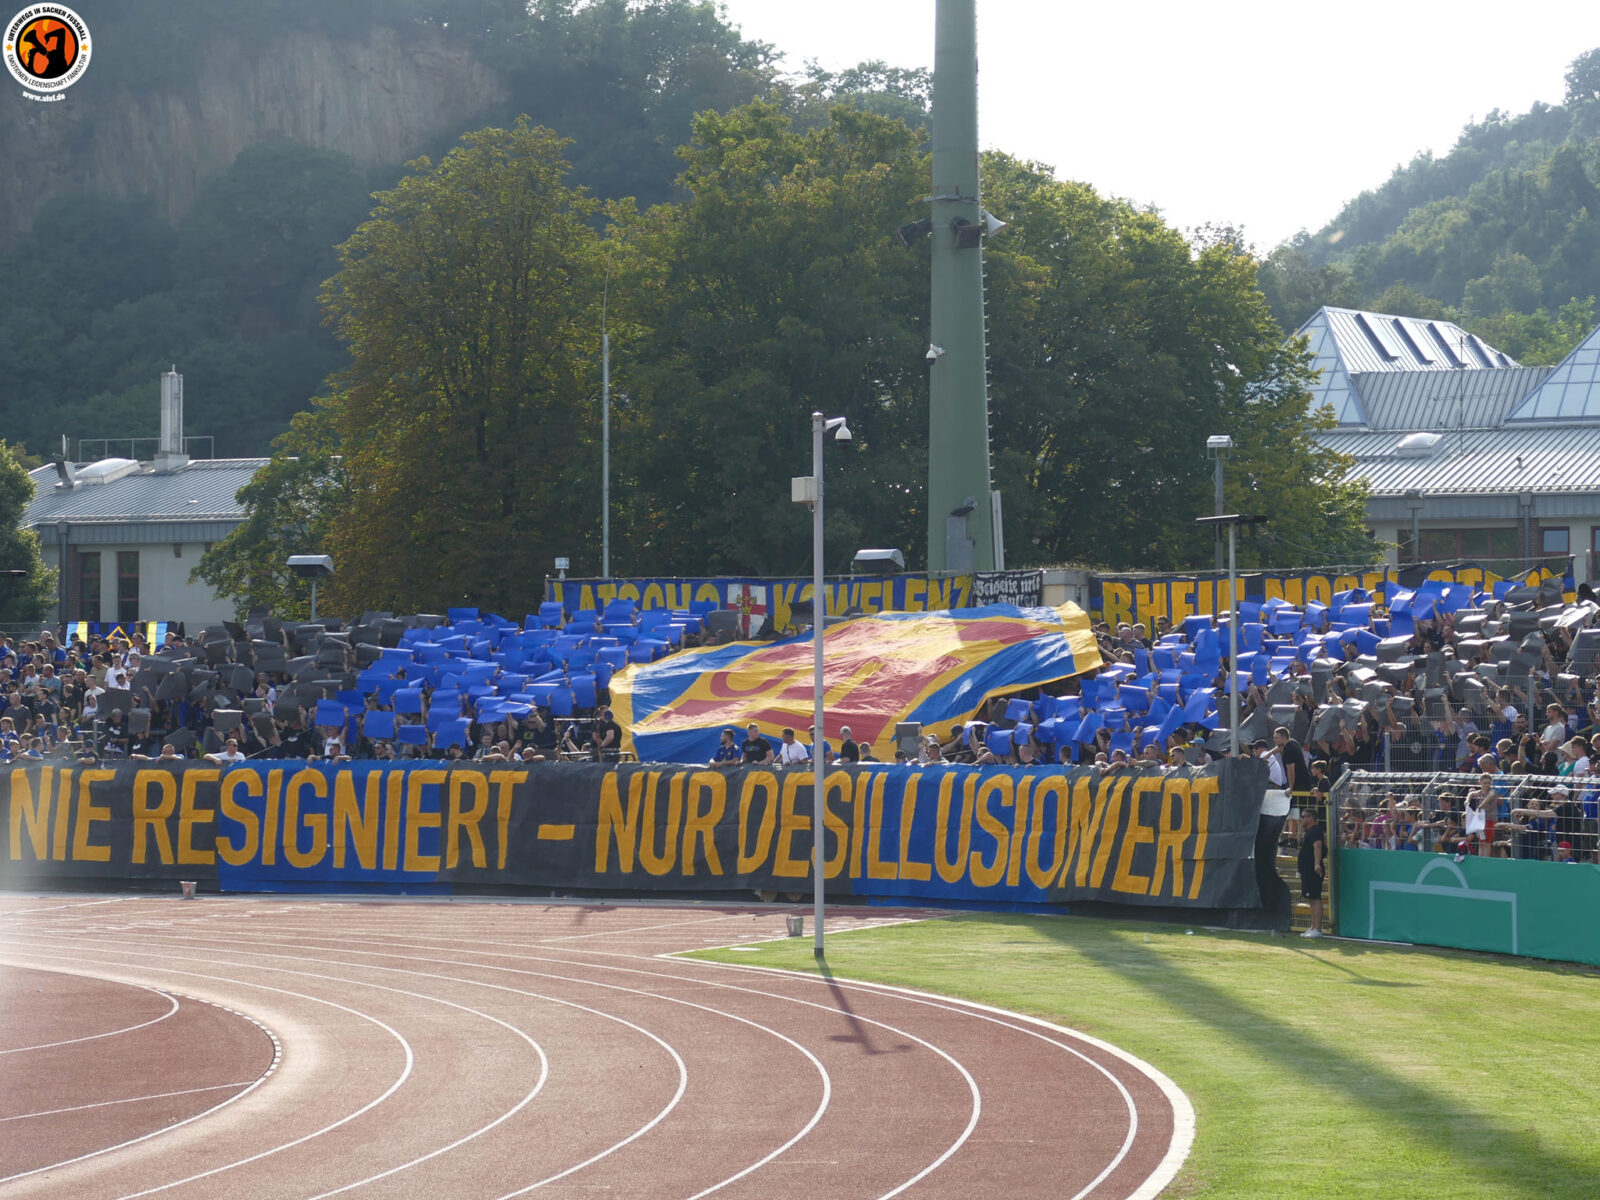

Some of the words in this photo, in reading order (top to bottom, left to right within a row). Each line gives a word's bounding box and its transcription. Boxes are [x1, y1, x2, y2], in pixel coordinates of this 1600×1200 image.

[9, 766, 117, 861] NIE
[132, 768, 529, 872] RESIGNIERT
[595, 771, 726, 876] NUR
[737, 770, 1219, 899] DESILLUSIONIERT
